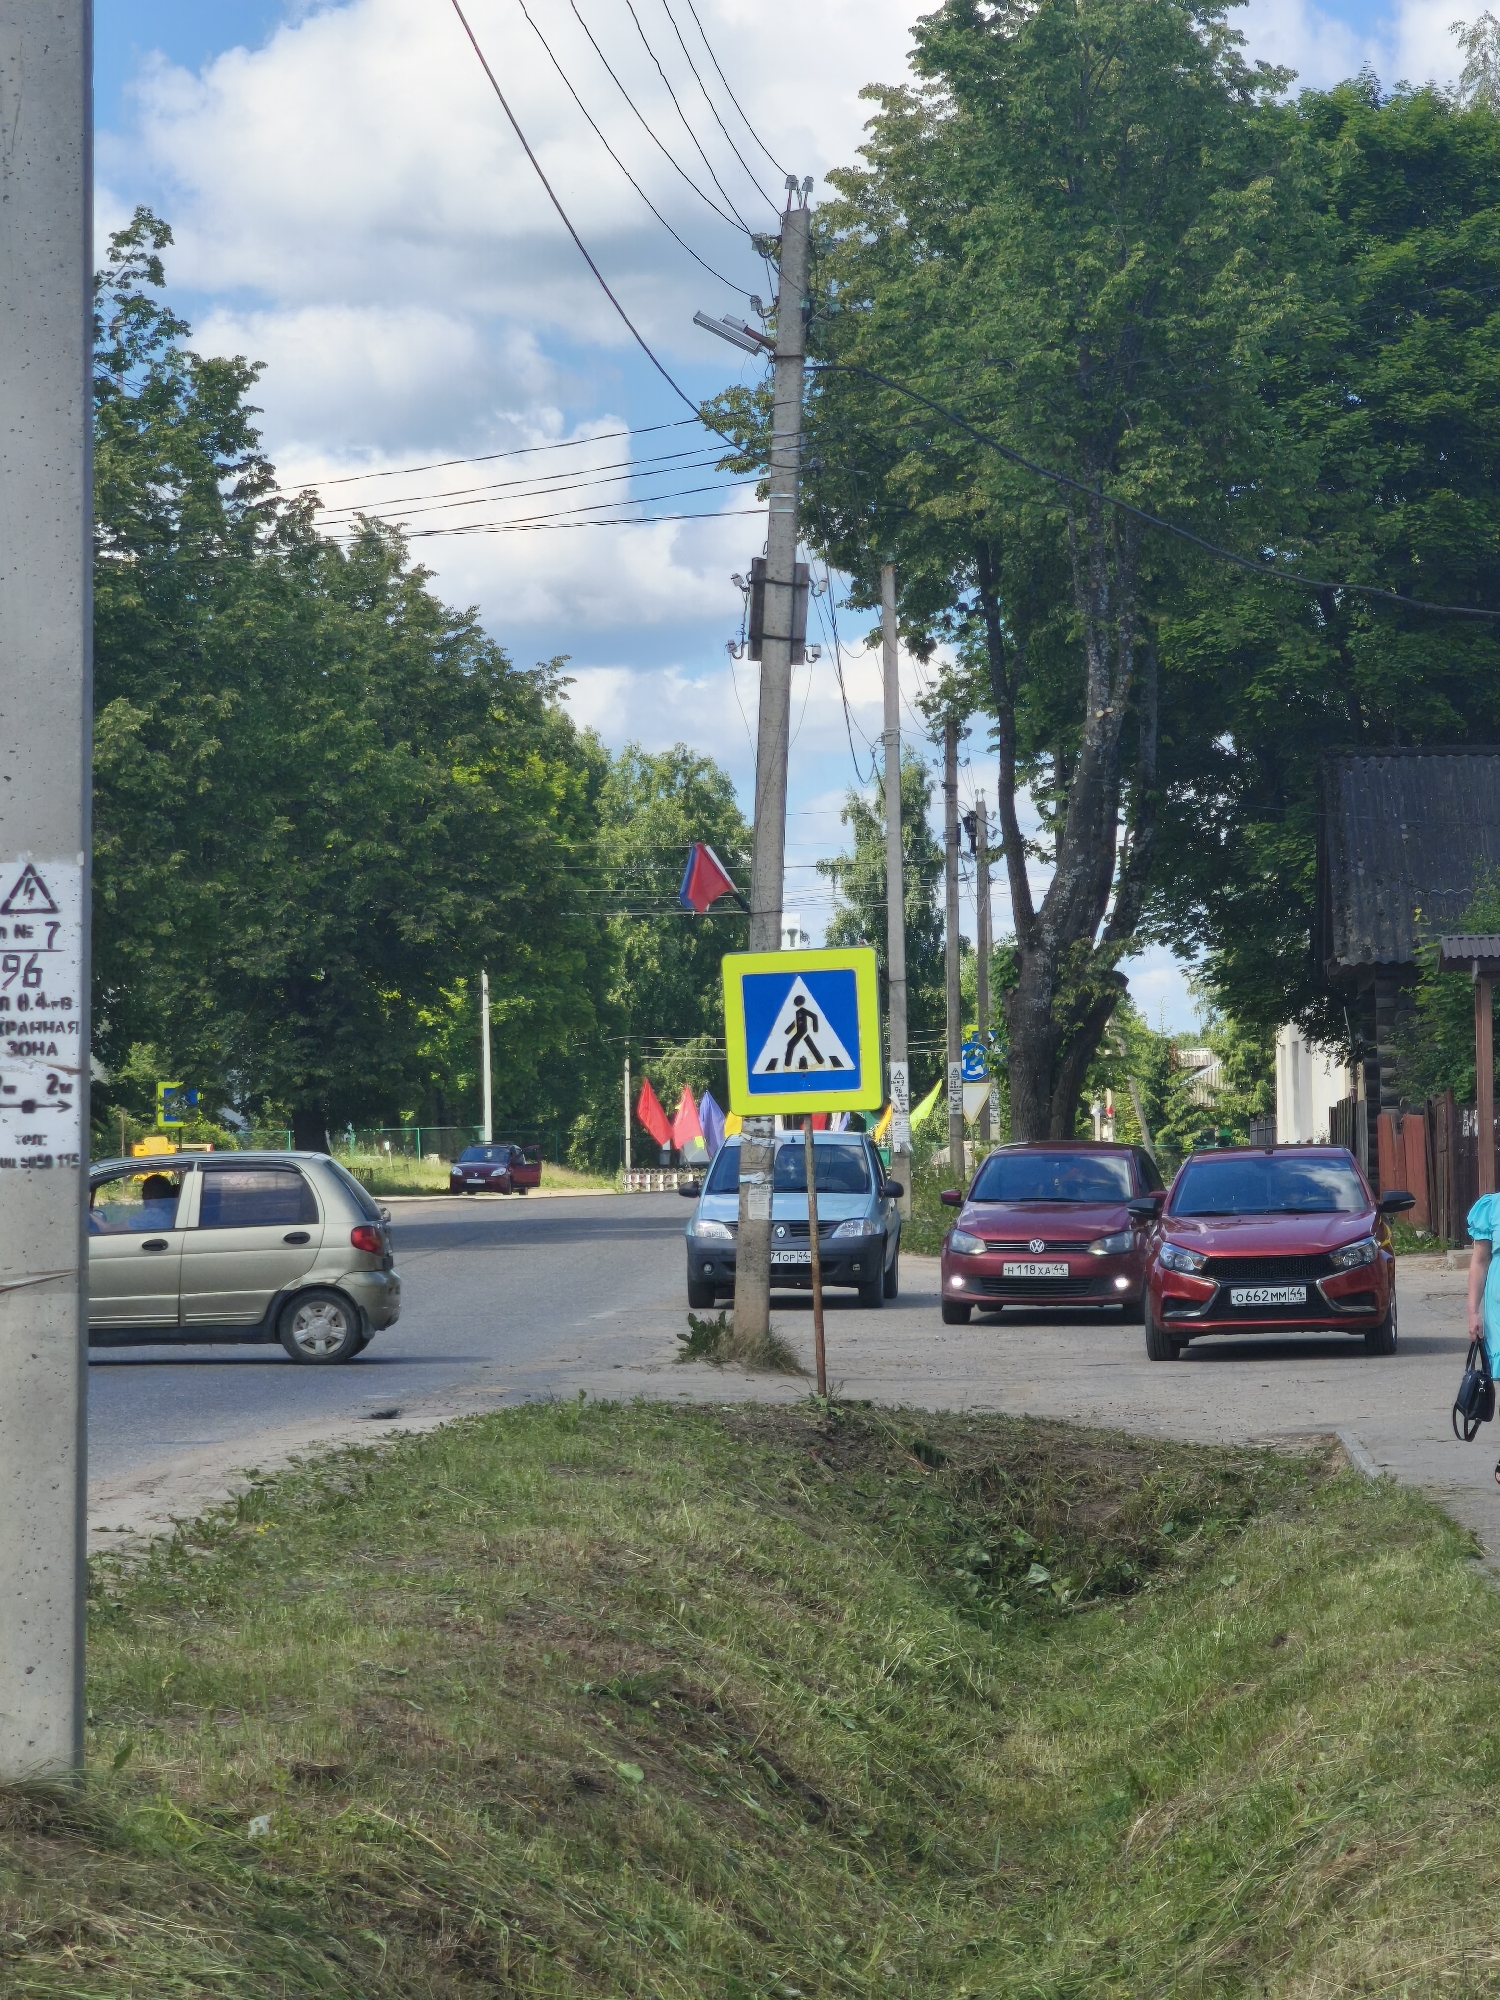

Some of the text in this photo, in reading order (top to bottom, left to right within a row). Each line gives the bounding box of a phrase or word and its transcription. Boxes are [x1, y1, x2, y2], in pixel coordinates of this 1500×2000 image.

[45, 921, 61, 950] 7
[2, 953, 43, 990] 96
[7, 1040, 58, 1057] ЗОНА
